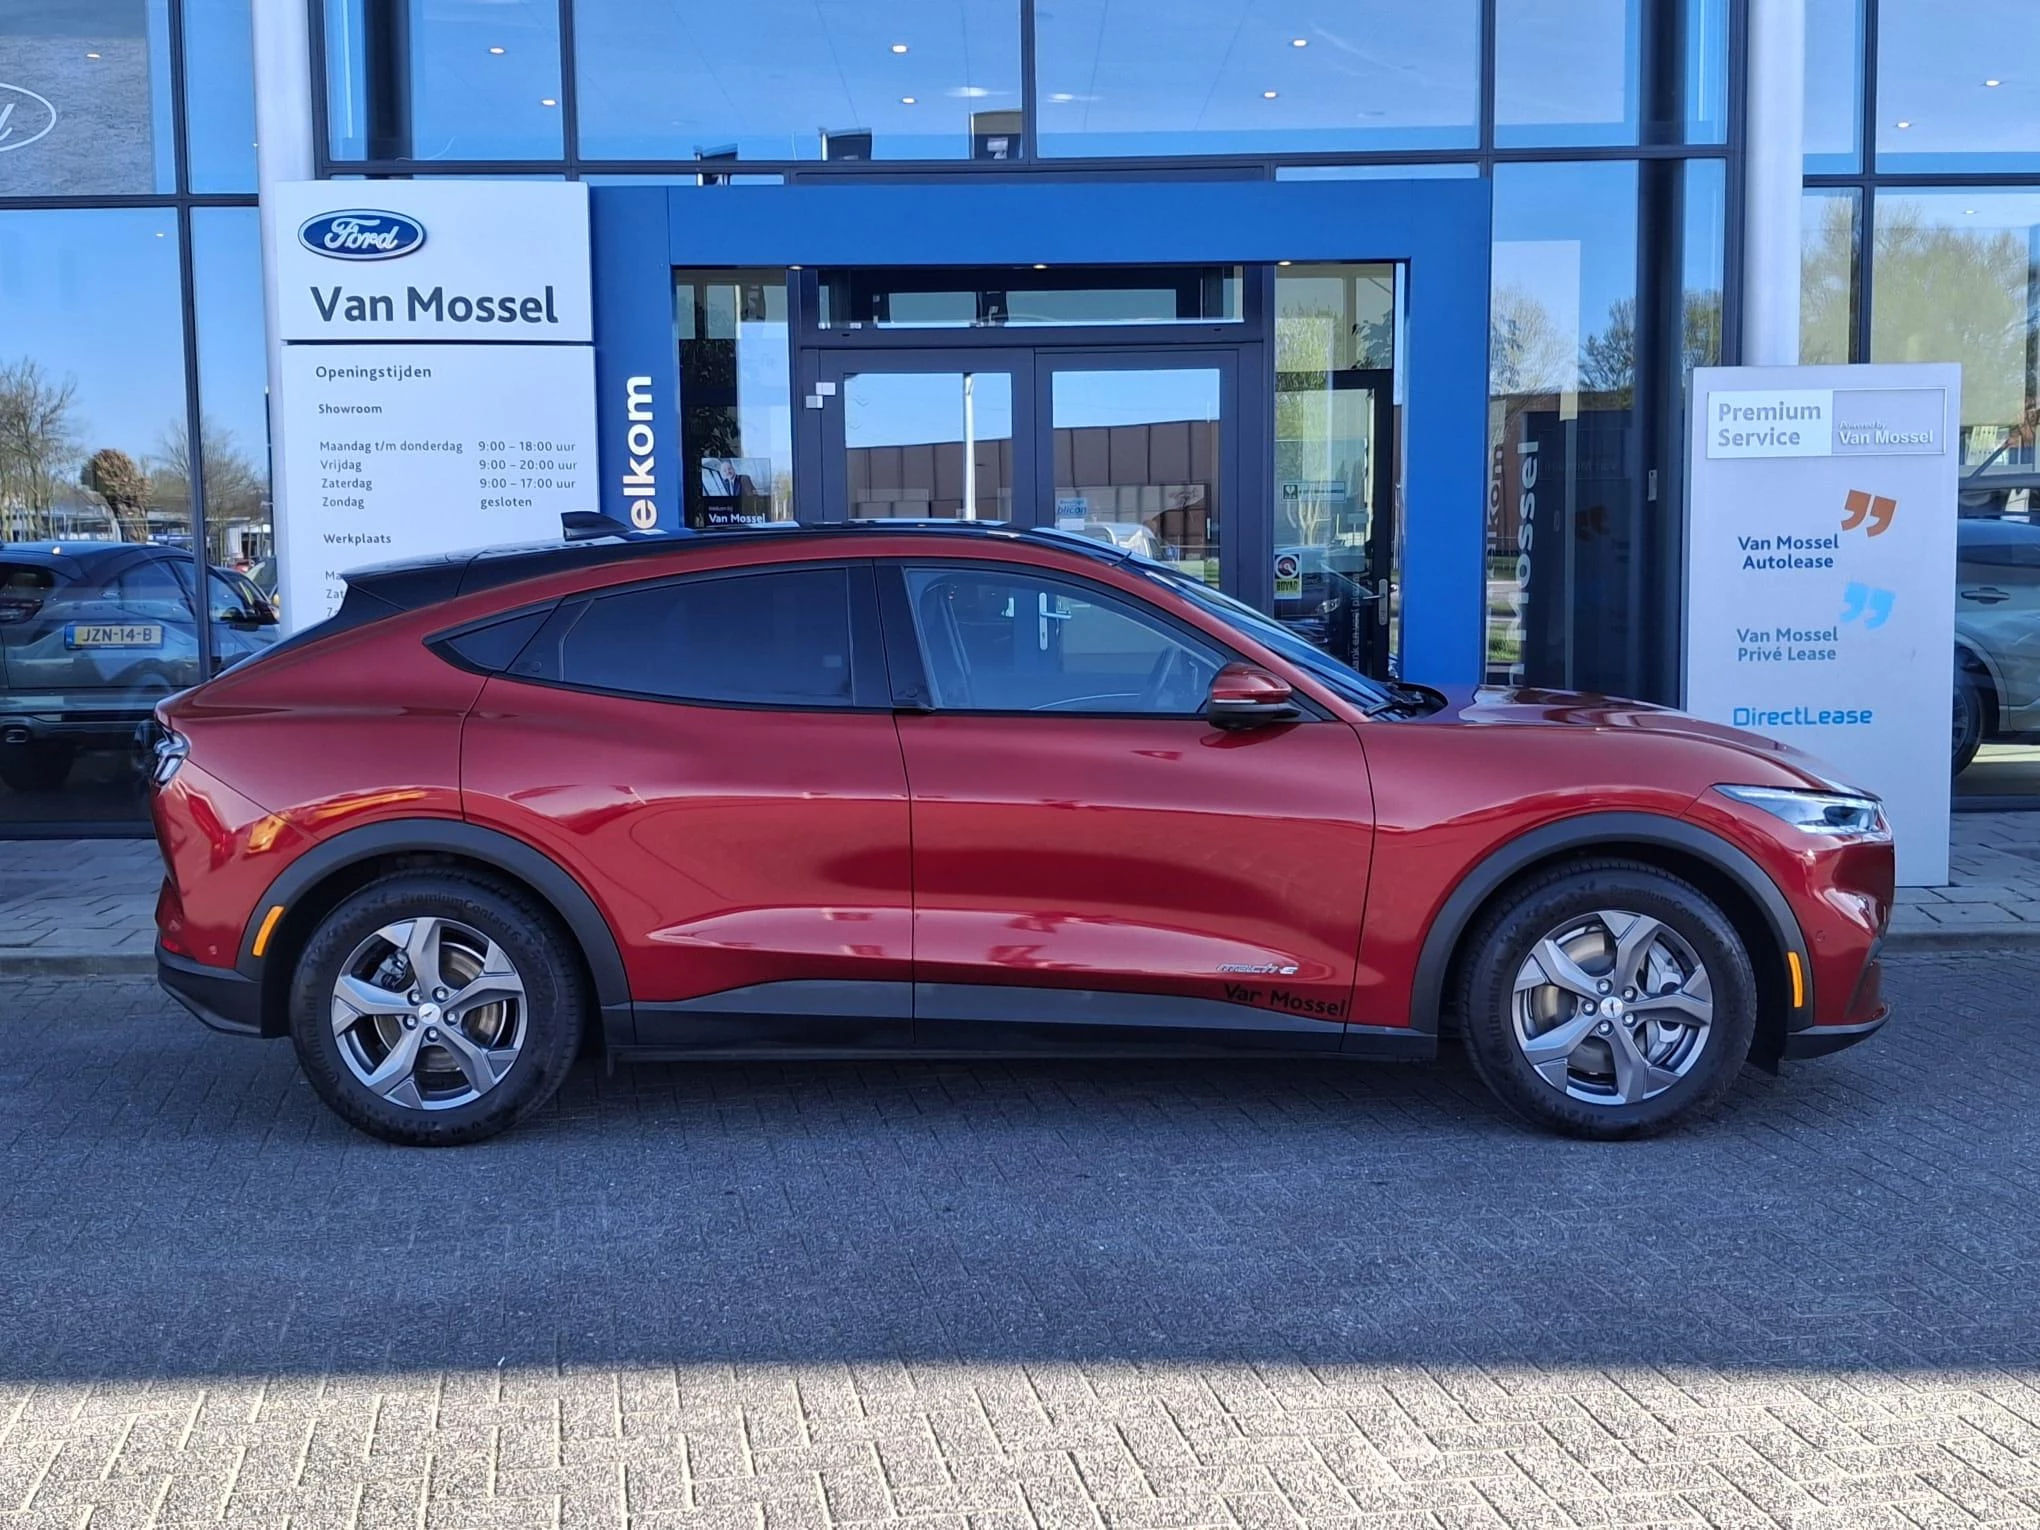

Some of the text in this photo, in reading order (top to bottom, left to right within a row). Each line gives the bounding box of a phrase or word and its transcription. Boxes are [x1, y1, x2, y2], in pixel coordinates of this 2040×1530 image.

[323, 216, 400, 250] Ford
[310, 285, 559, 323] Van Mossel
[315, 366, 432, 381] Openingstijden
[318, 403, 383, 414] Showroom
[1718, 401, 1822, 422] Premium
[1718, 427, 1801, 447] Service
[1839, 429, 1934, 445] Van Mossel
[319, 441, 371, 454] Maandag
[375, 441, 397, 451] t/m
[400, 441, 463, 453] donderdag
[478, 441, 506, 451] 9:00
[519, 441, 552, 451] 18:00
[556, 444, 576, 452] uur
[623, 376, 657, 530] elkom
[320, 459, 362, 473] Vrijdag
[479, 460, 506, 470] 9:00
[519, 460, 554, 470] 20:00
[558, 462, 578, 470] uur
[321, 478, 373, 491] Zaterdag
[479, 478, 507, 489] 9:00
[521, 478, 553, 489] 17:00
[556, 481, 576, 489] uur
[322, 497, 533, 510] Zondag gesloten
[708, 512, 766, 524] Van Mossel
[323, 533, 392, 546] Werkplaats
[1506, 441, 1539, 641] Mossel
[1738, 533, 1840, 551] Van Mossel
[1742, 553, 1834, 570] Autolease
[82, 627, 152, 642] JZN-14-B
[1737, 626, 1839, 643] Van Mossel
[1738, 646, 1837, 661] Privé Lease
[1733, 707, 1873, 726] DirectLease
[1270, 989, 1346, 1017] Mossel
